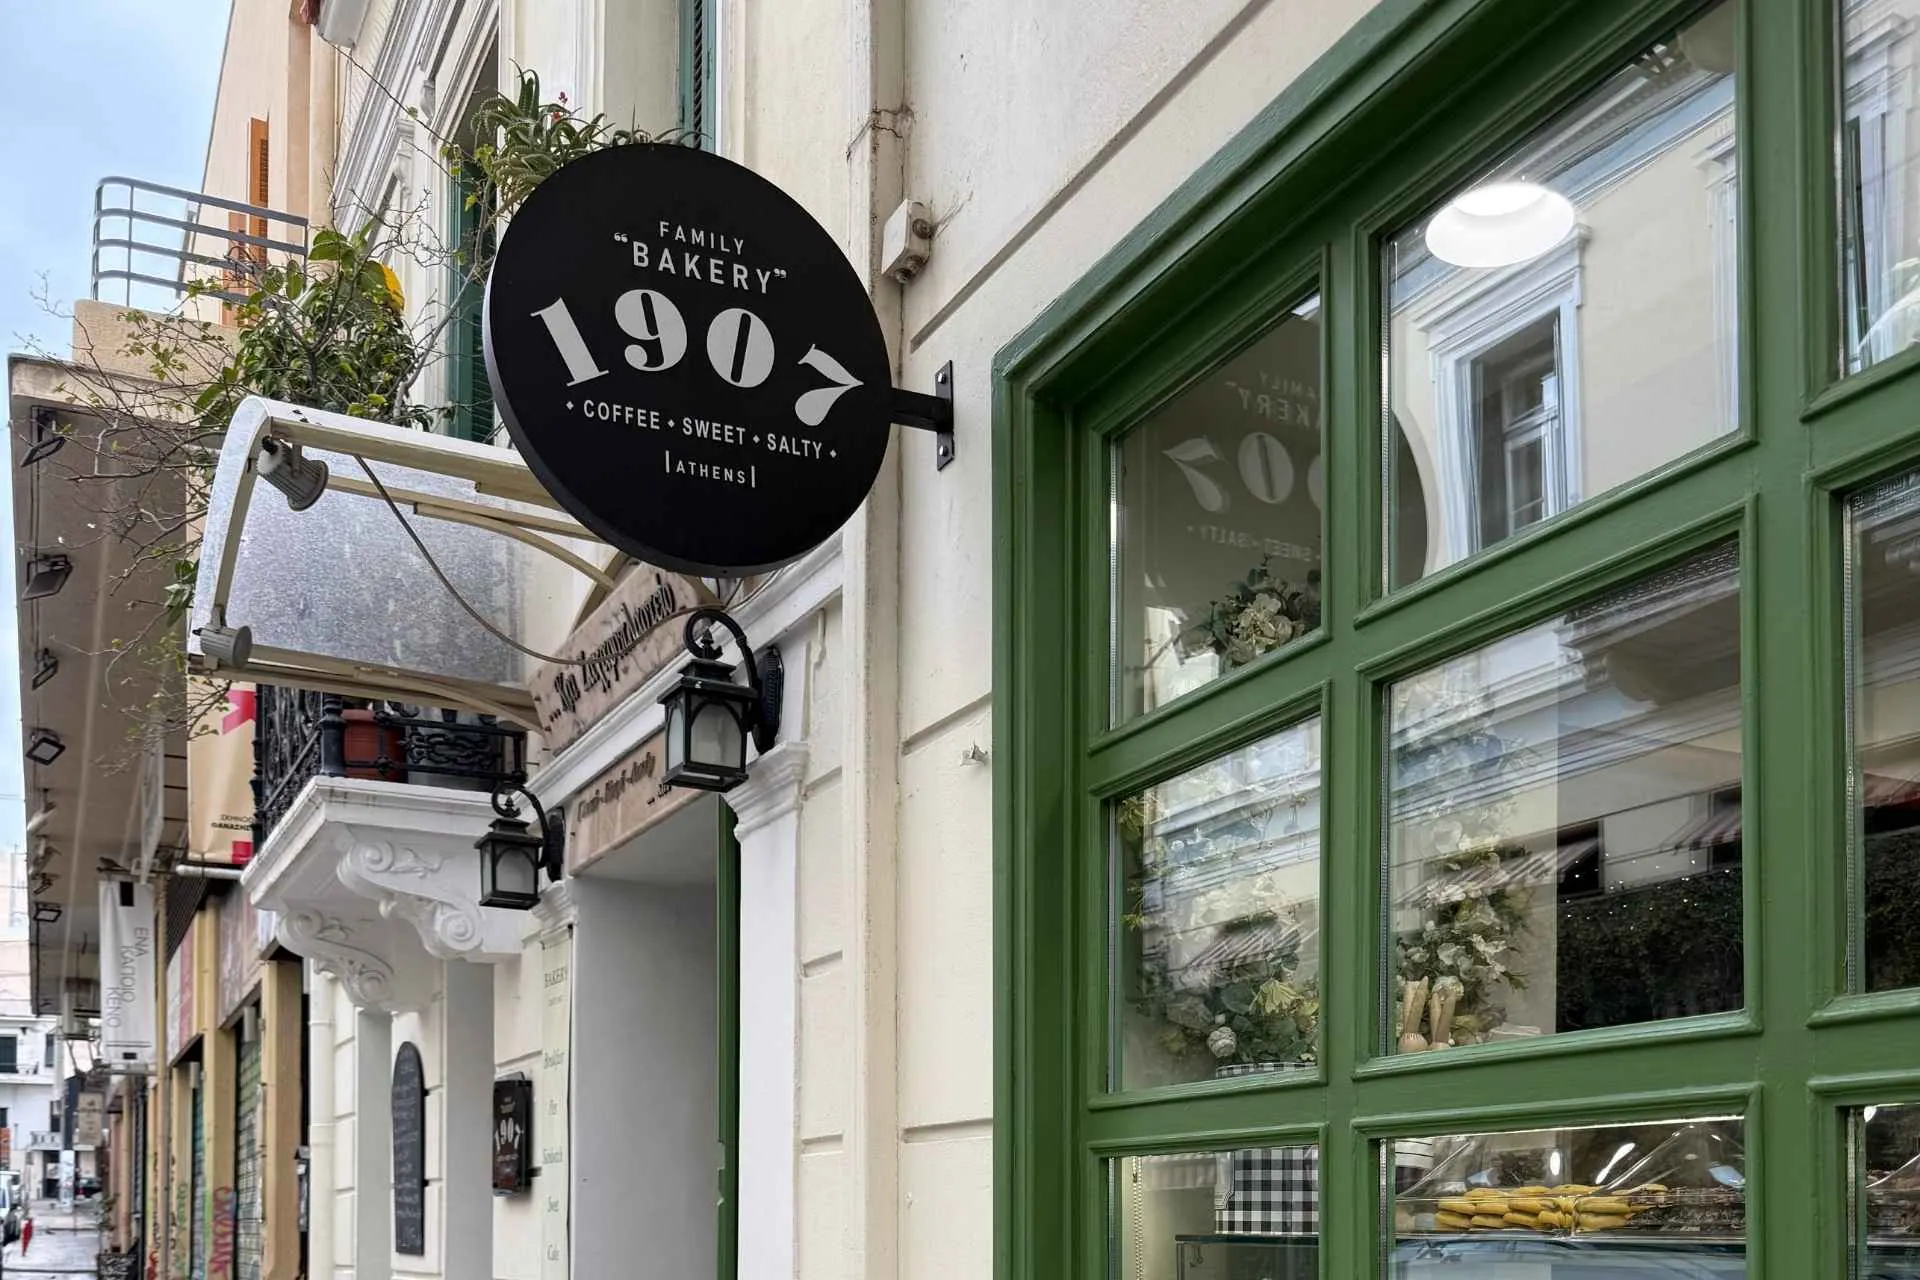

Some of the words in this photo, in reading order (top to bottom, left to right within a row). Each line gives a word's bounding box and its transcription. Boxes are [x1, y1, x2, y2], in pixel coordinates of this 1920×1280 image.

[659, 221, 745, 255] FAMILY
[530, 288, 864, 426] 1907
[583, 399, 660, 429] COFFEE
[682, 417, 746, 446] SWEET
[767, 432, 823, 460] SALTY
